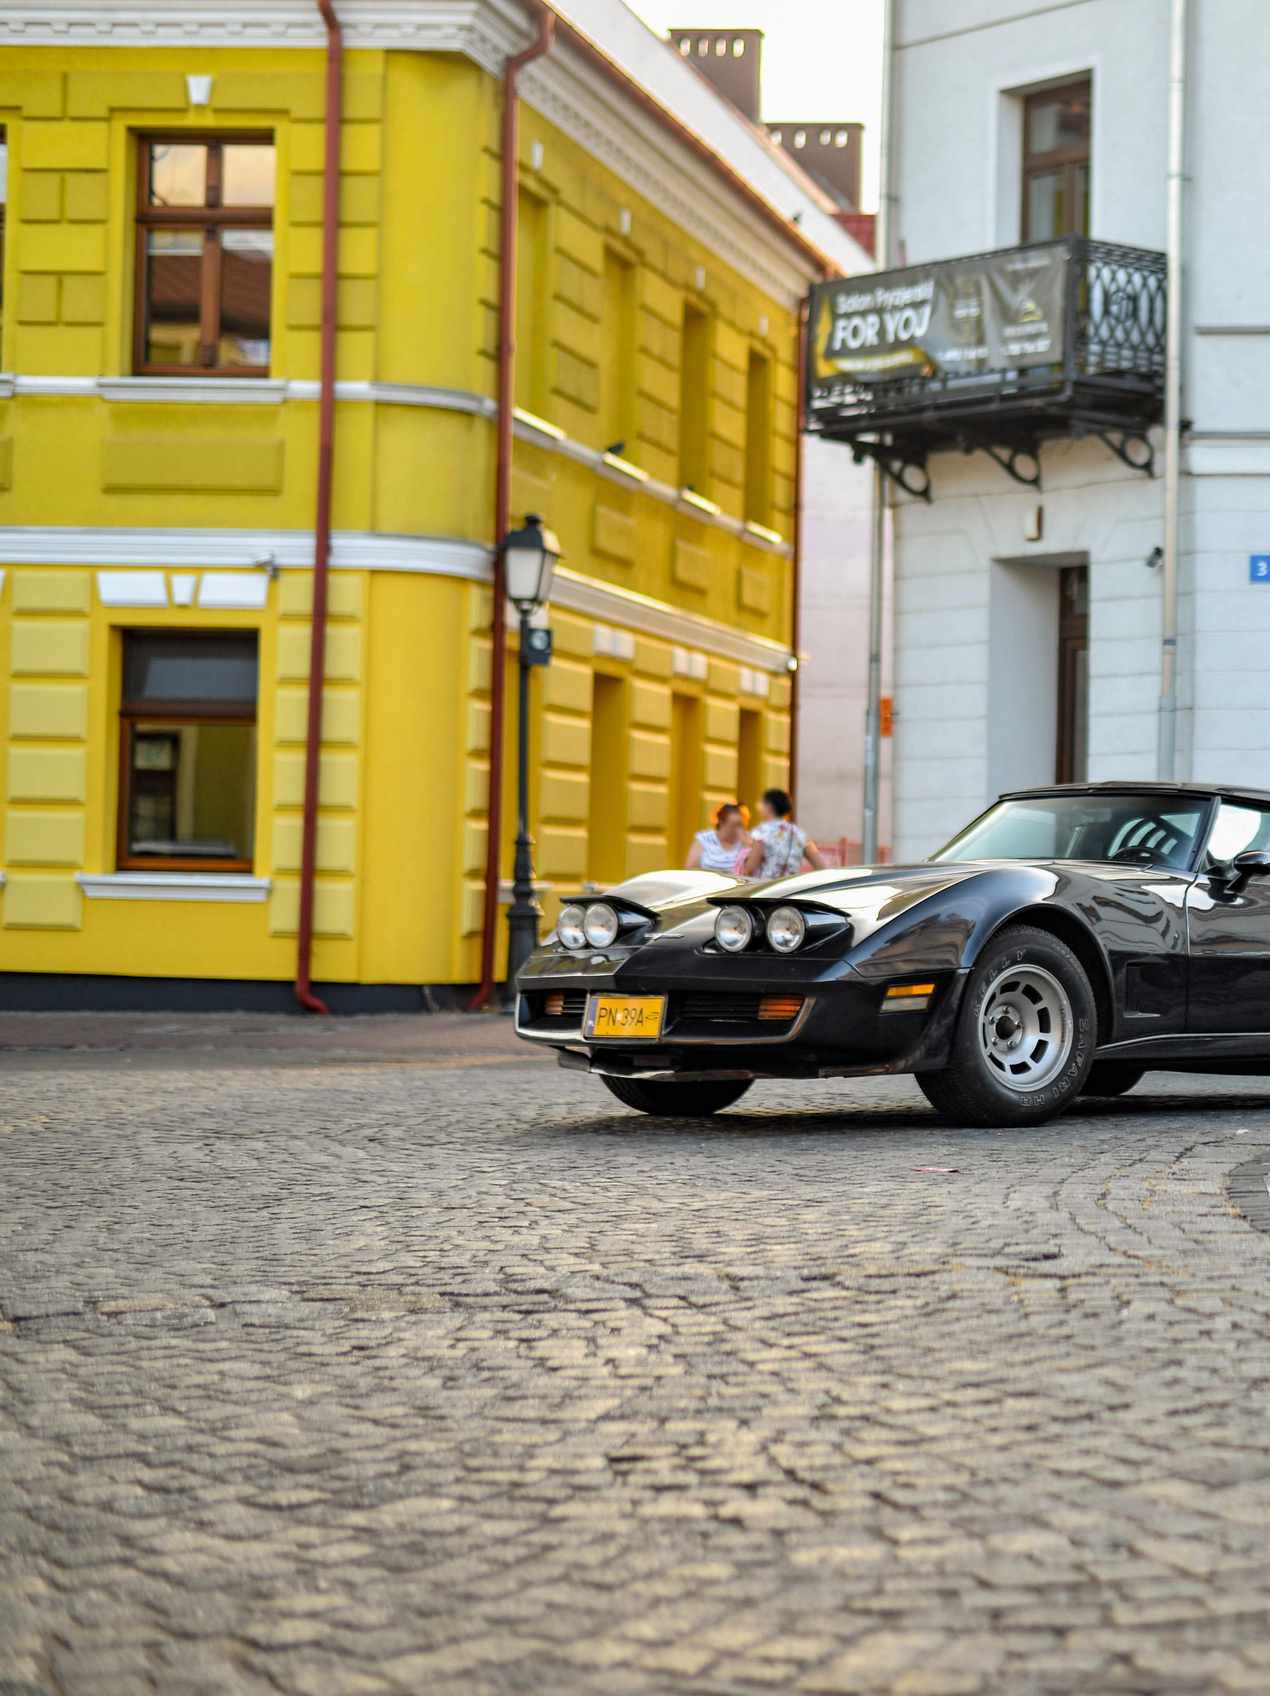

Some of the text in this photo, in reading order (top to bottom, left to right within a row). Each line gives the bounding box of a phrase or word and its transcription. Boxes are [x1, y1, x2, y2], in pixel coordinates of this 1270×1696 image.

[832, 313, 879, 351] FOR
[883, 302, 932, 343] YOU
[1257, 562, 1267, 576] 3
[973, 949, 1026, 1018] KELLY
[597, 1007, 644, 1027] PN 39A
[1020, 1018, 1090, 1107] SAFARI HR
